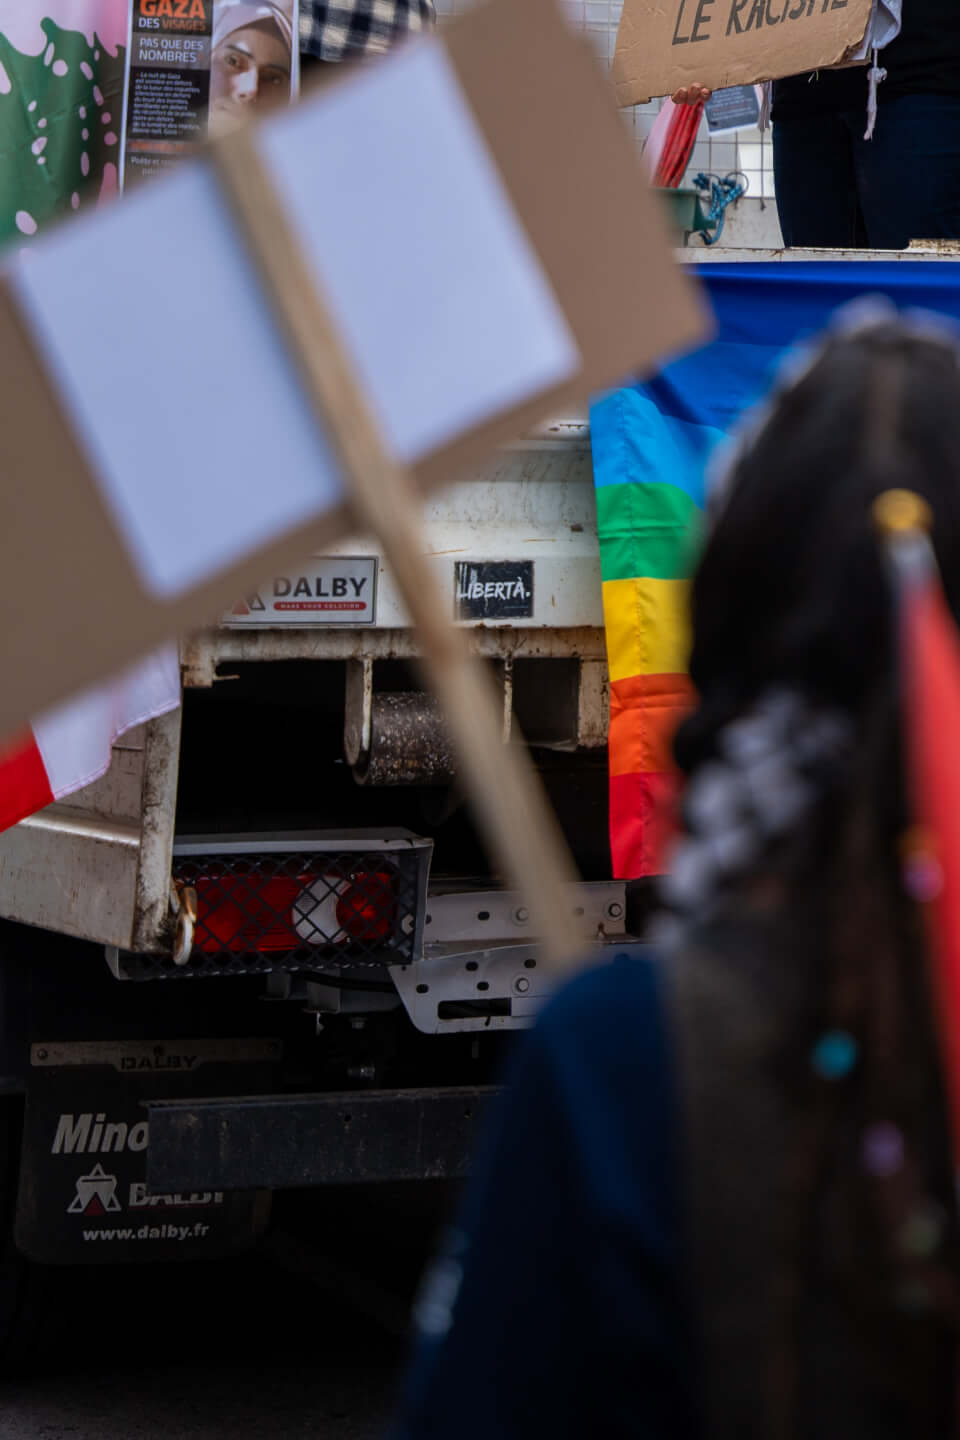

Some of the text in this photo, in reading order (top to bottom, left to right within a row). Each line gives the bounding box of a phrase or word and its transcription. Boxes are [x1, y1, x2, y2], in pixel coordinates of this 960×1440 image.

[138, 17, 206, 31] DES VISAGES
[140, 37, 204, 50] PAS QUE DES
[139, 50, 197, 63] NOMBRES
[273, 576, 367, 597] DALBY
[120, 1055, 198, 1070] DALBY
[82, 1222, 210, 1242] www.dalby.fr
